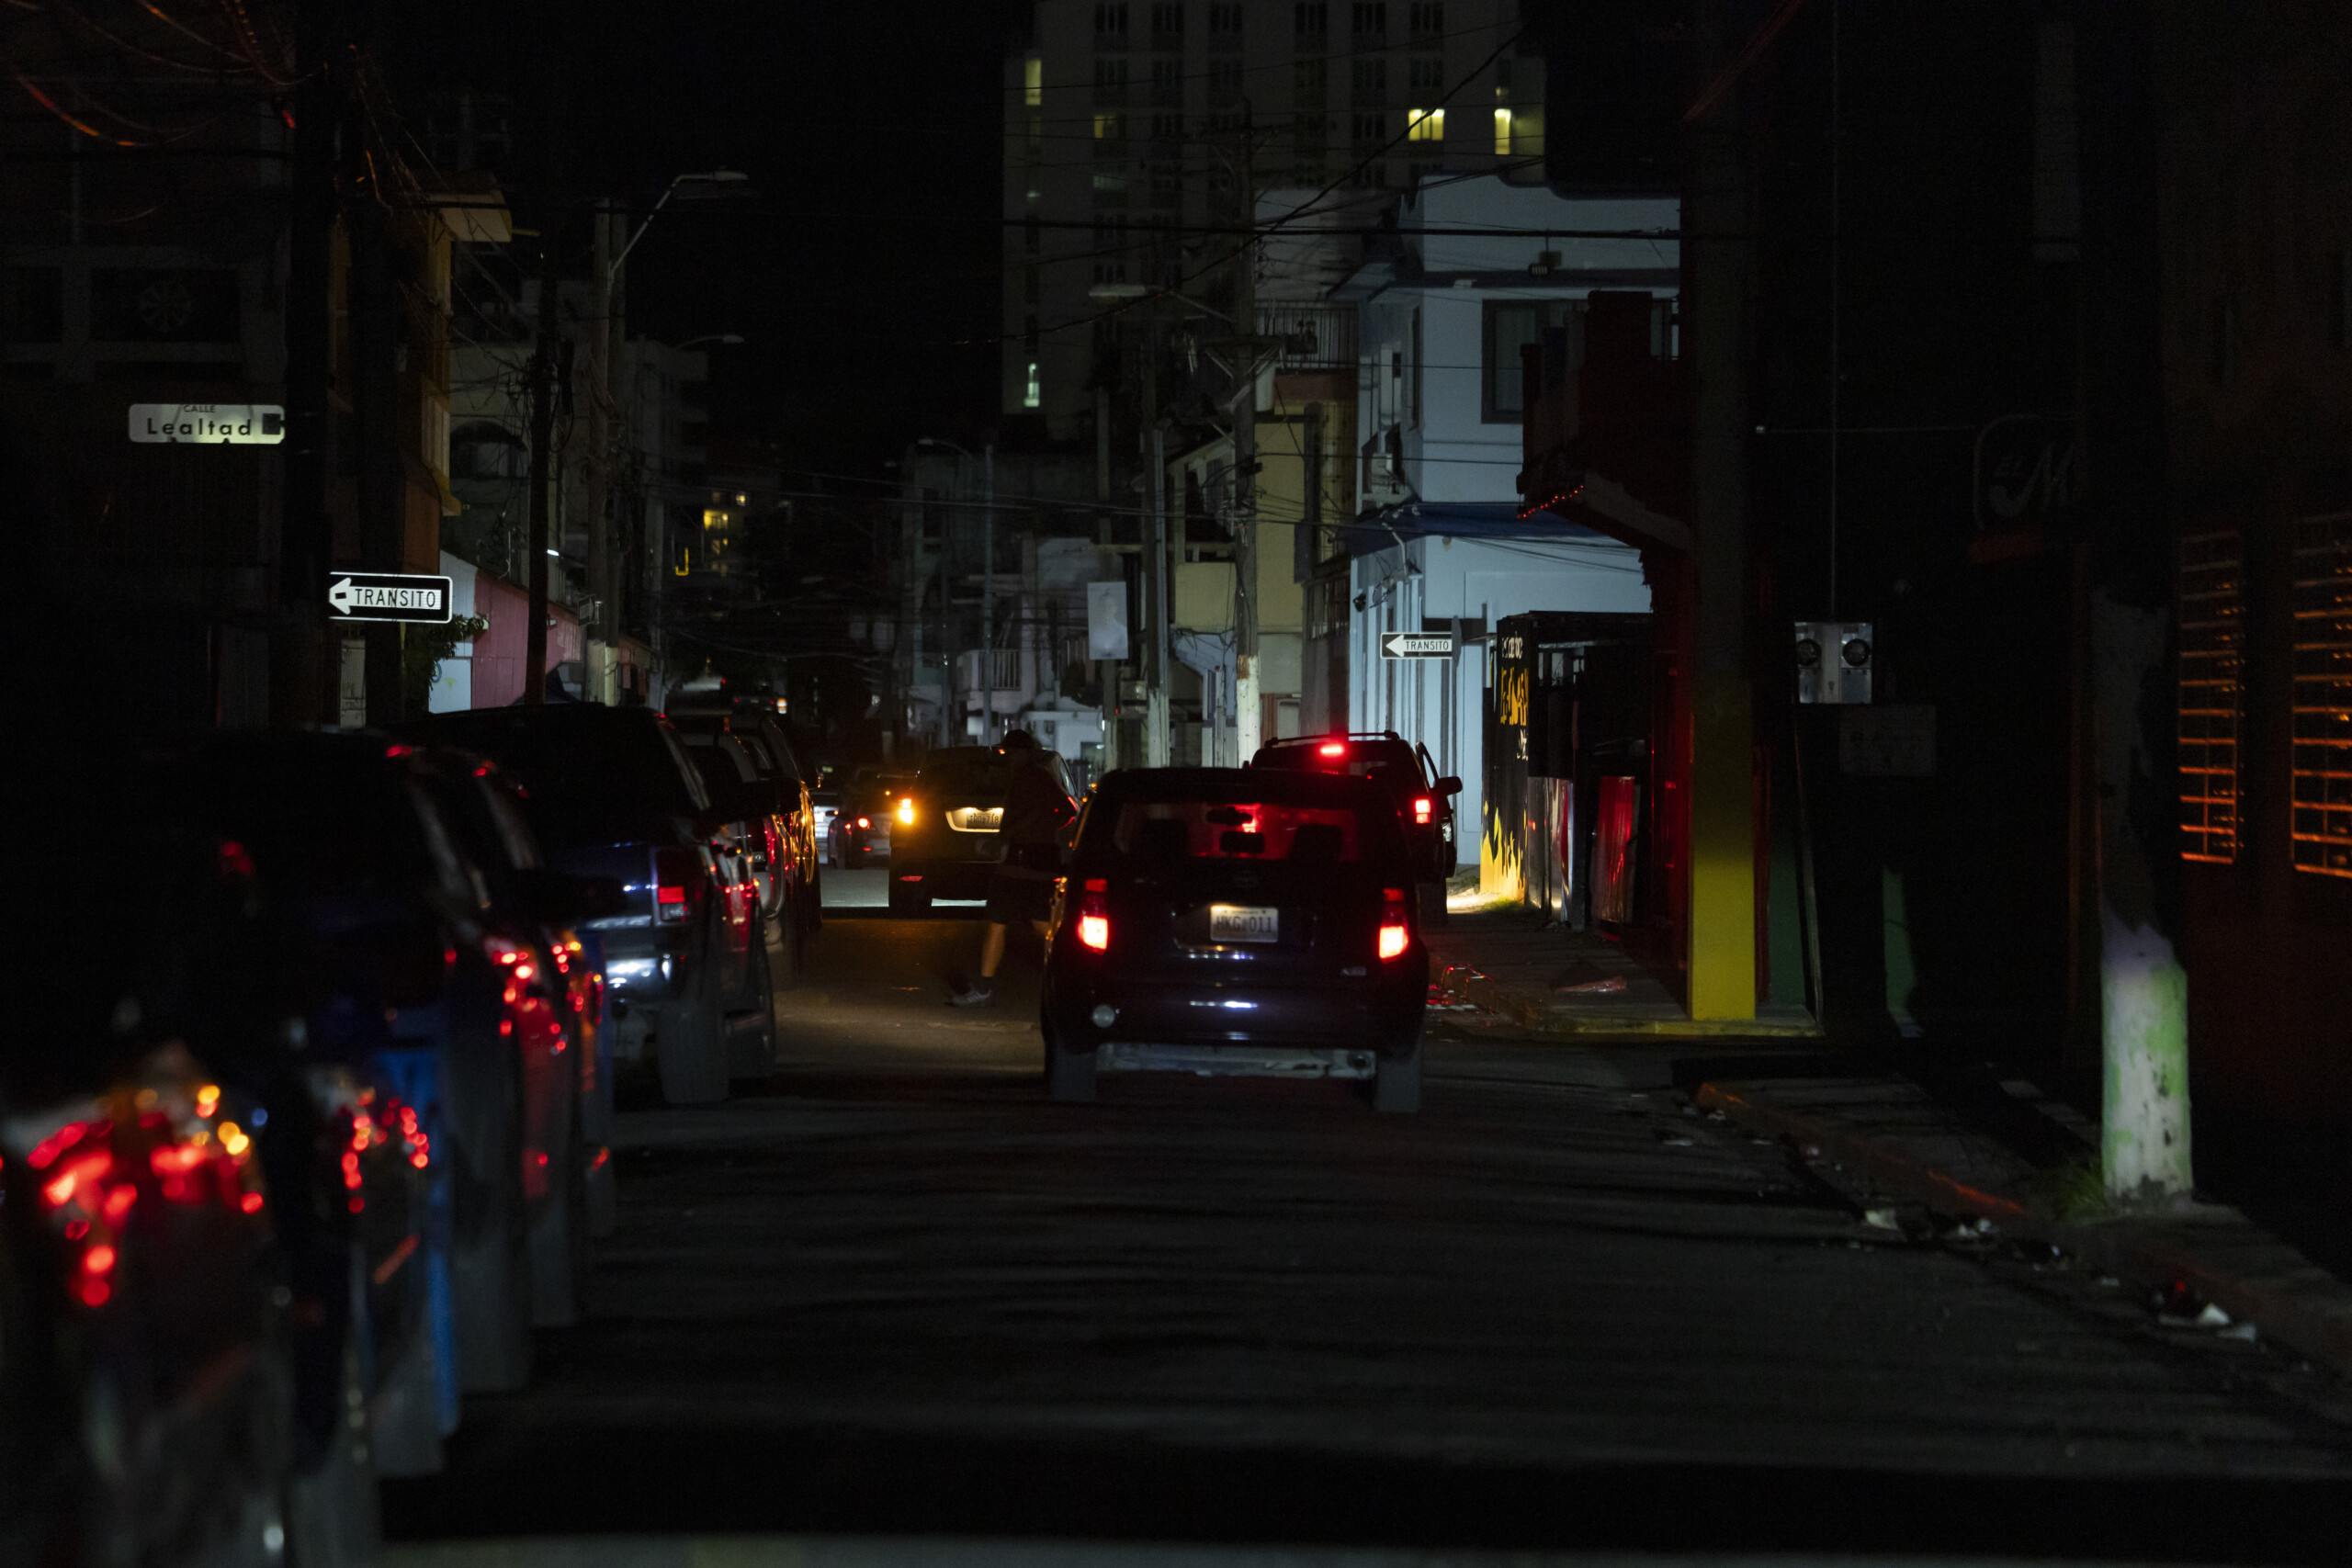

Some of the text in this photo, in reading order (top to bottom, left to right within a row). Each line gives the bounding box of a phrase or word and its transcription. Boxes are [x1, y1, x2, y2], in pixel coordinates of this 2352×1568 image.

[183, 404, 216, 413] CALLE
[147, 417, 252, 435] Lealtad
[355, 588, 435, 608] TRANSITO
[1406, 640, 1449, 650] TRANSITO
